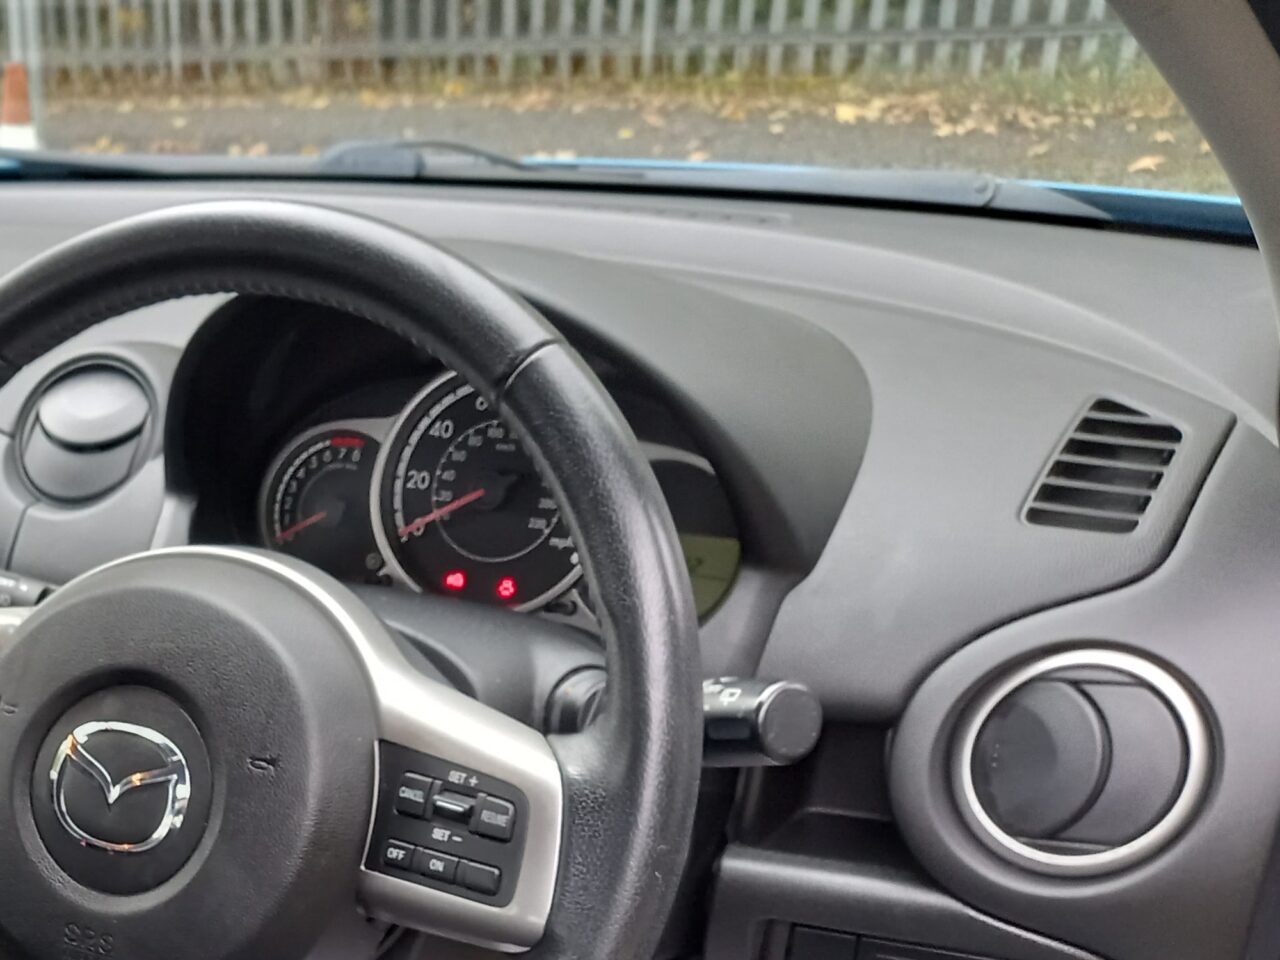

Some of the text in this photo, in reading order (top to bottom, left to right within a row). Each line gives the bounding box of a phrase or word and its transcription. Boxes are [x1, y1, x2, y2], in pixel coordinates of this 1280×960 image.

[429, 420, 455, 439] 40
[406, 470, 431, 490] 20
[448, 770, 468, 785] SET
[431, 827, 452, 842] SET
[386, 848, 407, 862] OFF
[429, 858, 445, 873] ON
